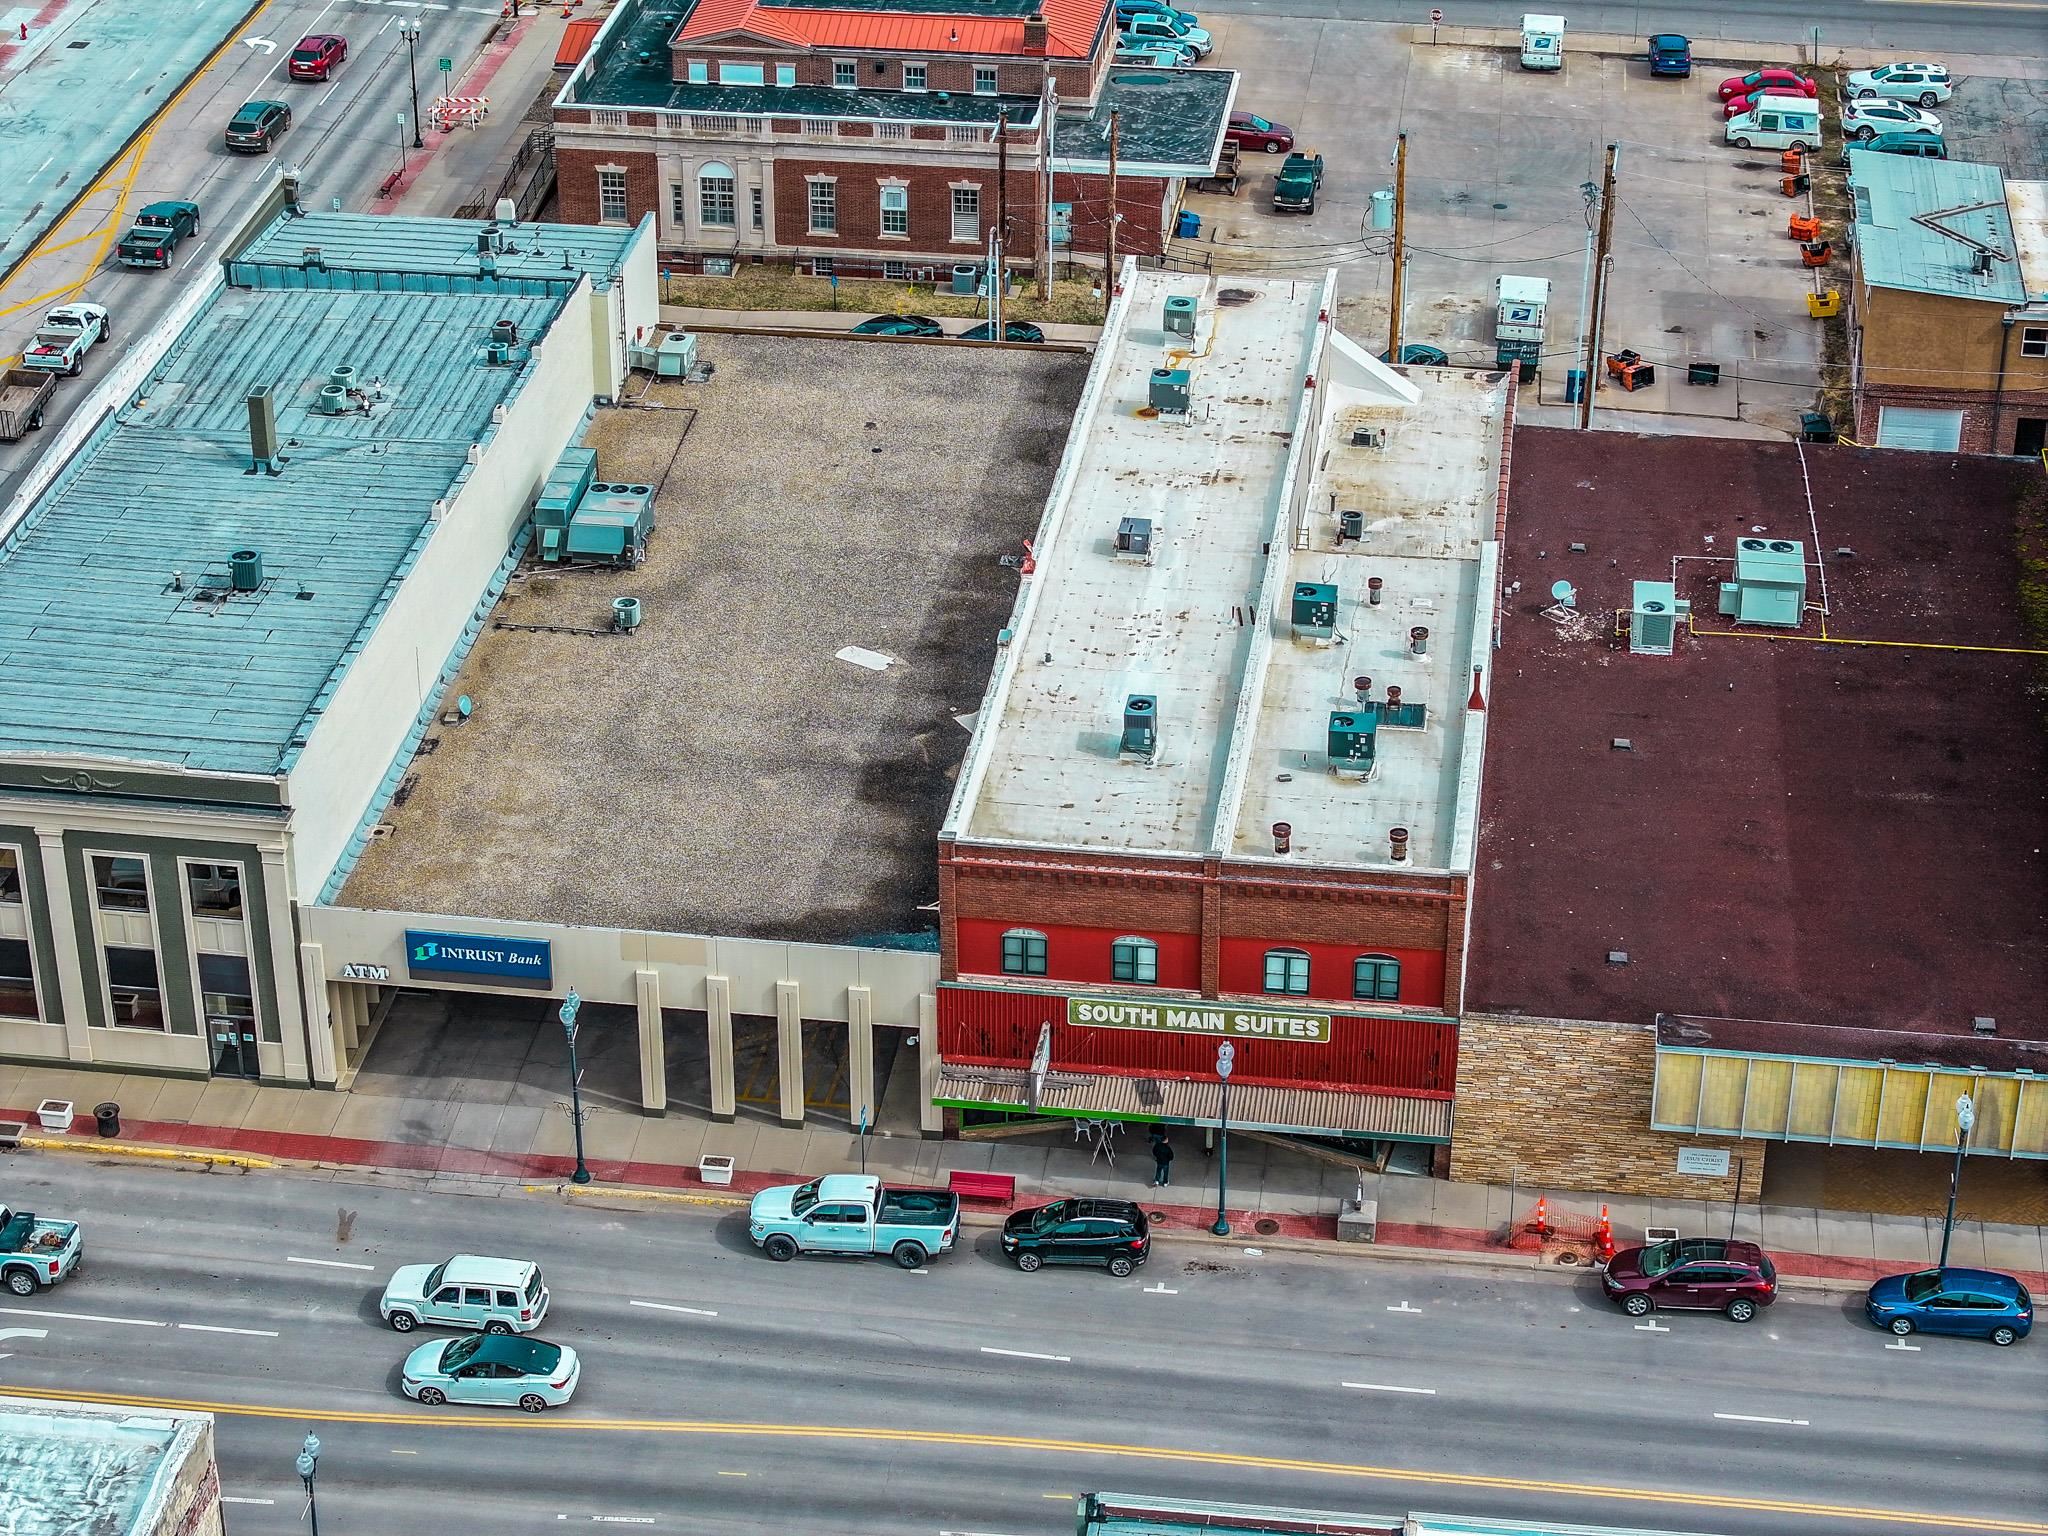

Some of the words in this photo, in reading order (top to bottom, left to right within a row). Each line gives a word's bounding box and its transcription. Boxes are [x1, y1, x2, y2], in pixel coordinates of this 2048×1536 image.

[441, 947, 504, 963] INTRUST
[508, 952, 542, 966] Bank
[343, 963, 387, 981] ATM
[1078, 1004, 1158, 1026] SOUTH
[1166, 1009, 1225, 1031] MAIN
[1234, 1014, 1320, 1037] SUITES
